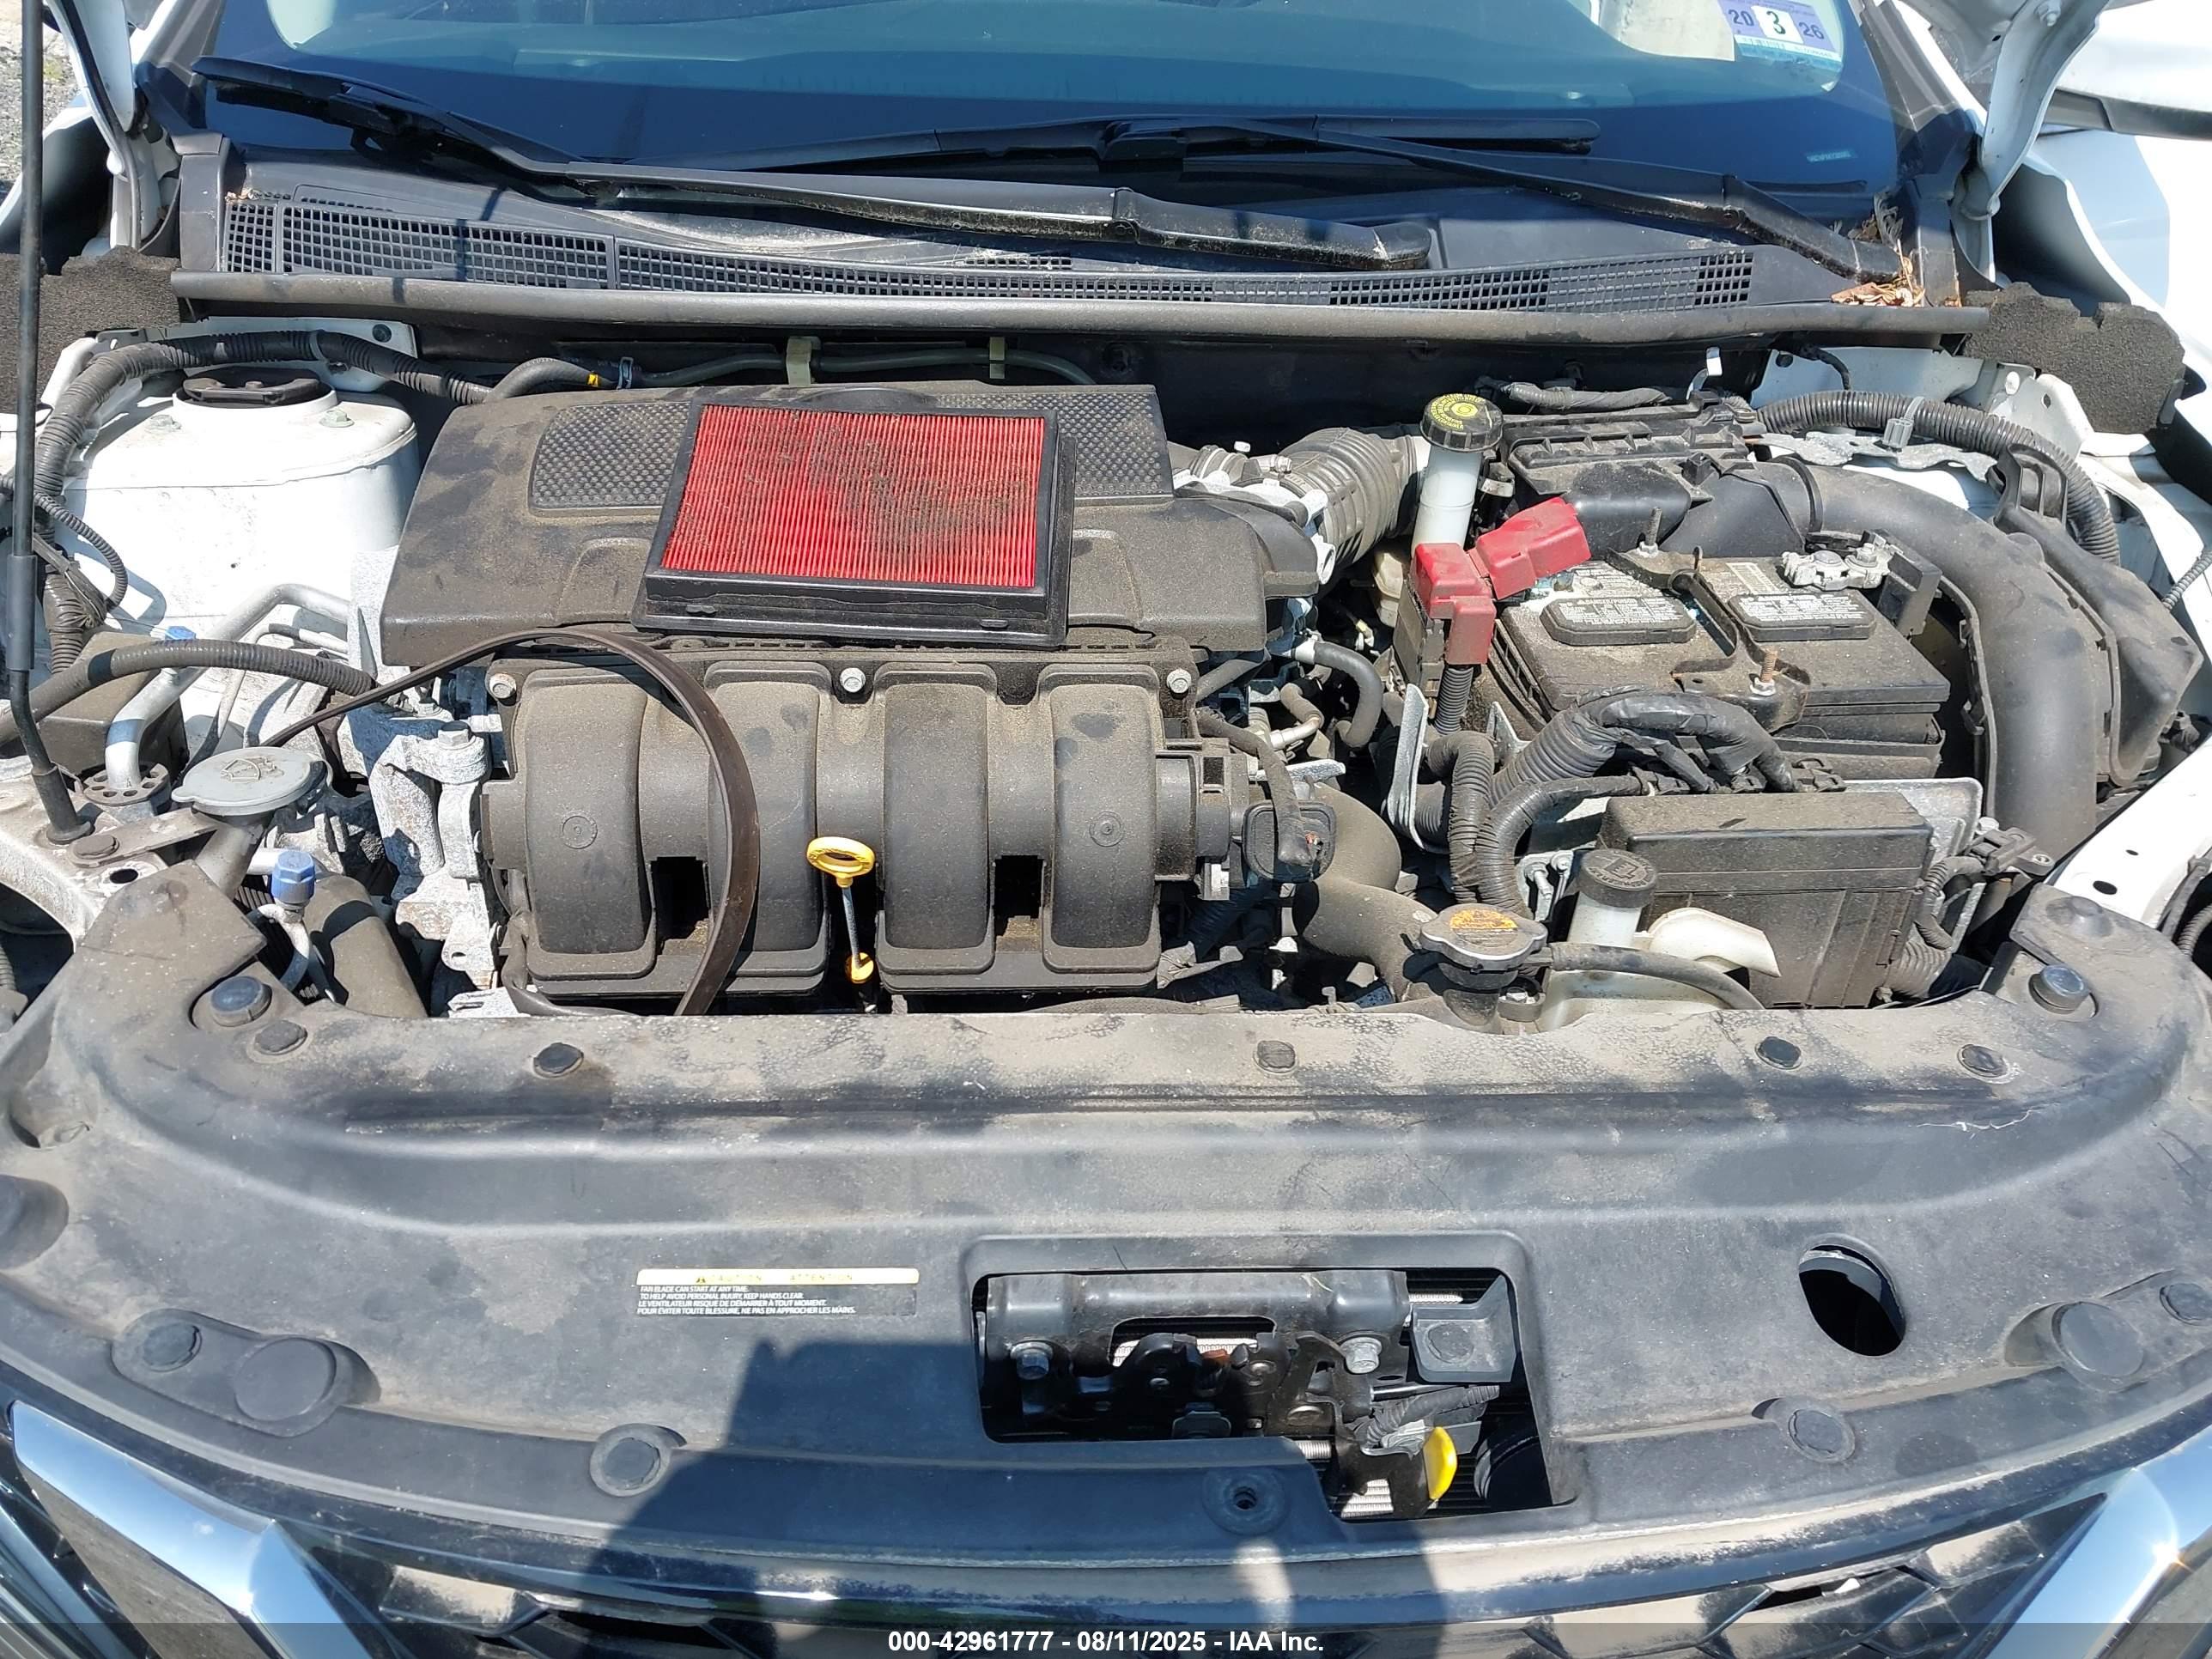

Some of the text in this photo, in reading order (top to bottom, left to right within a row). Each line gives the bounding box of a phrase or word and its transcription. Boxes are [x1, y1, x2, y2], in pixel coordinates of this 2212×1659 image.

[1728, 9, 1825, 40] 20 3 26
